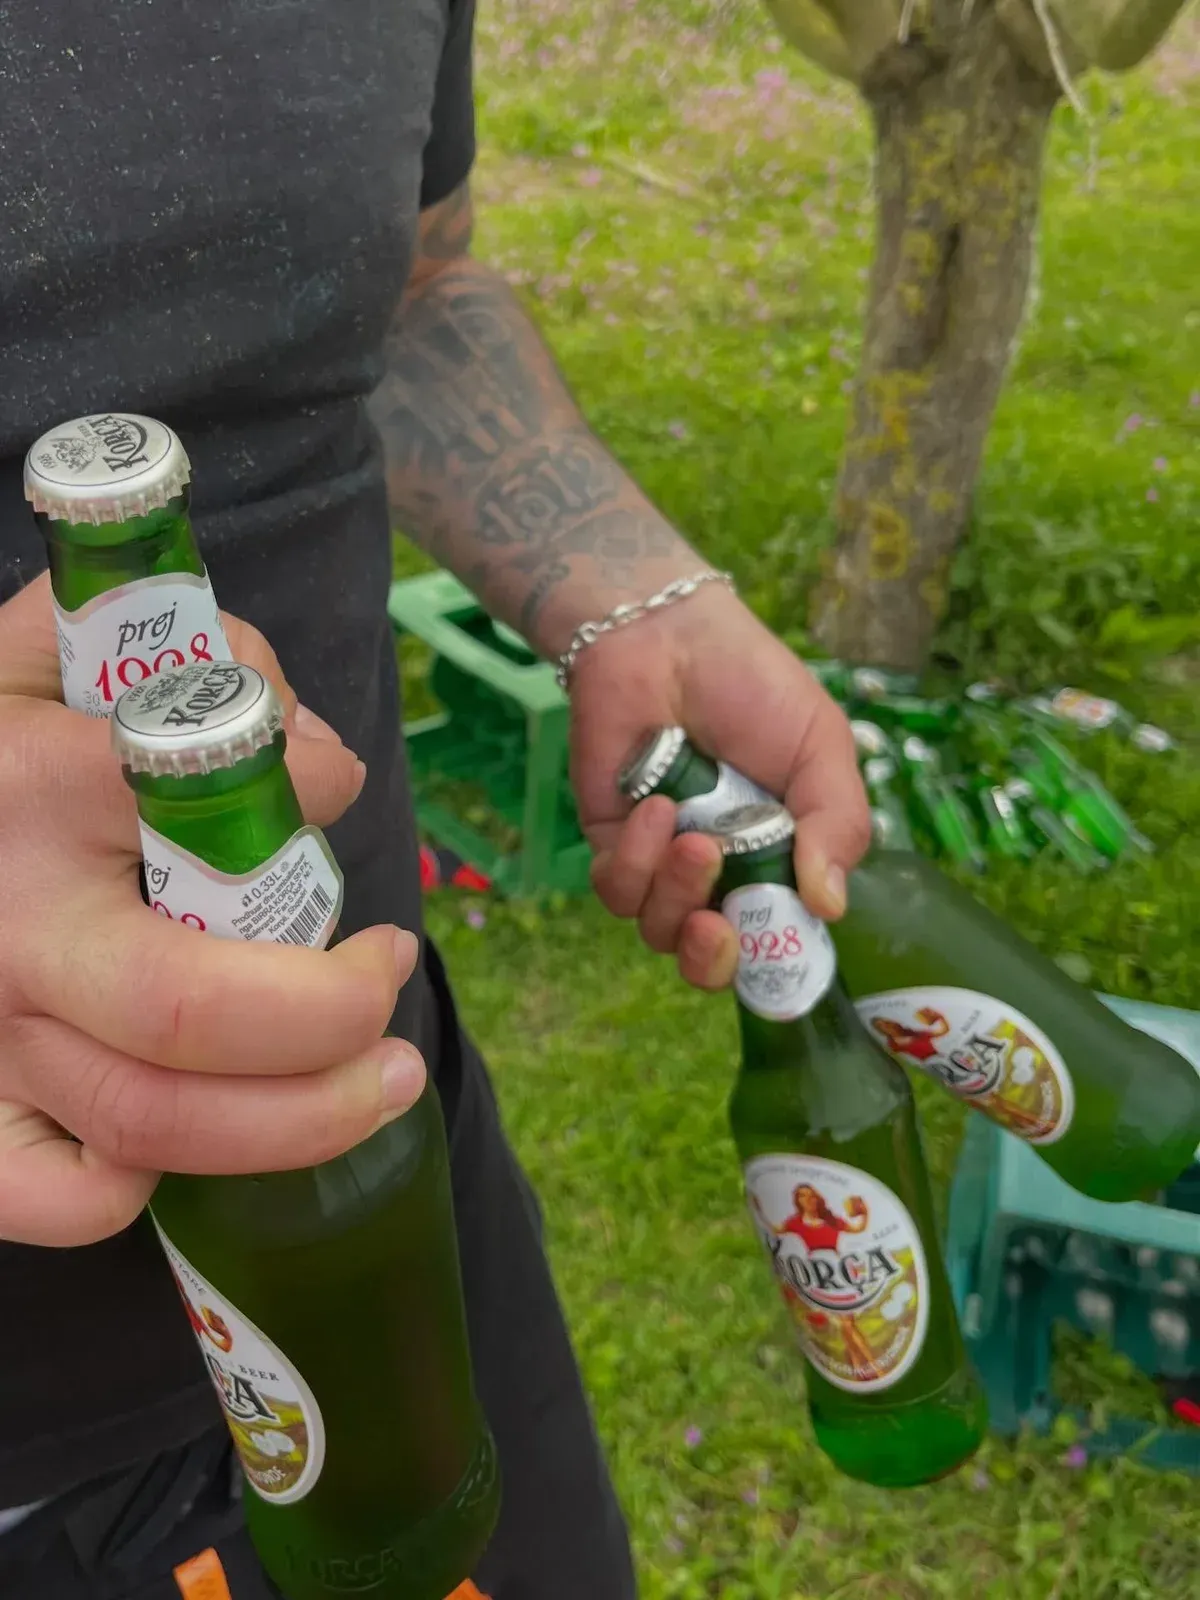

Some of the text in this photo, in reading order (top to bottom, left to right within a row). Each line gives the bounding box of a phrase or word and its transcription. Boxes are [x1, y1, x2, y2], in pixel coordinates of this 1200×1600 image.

[89, 415, 148, 472] KORÇA
[116, 601, 177, 656] prej
[162, 665, 240, 727] KORÇA
[145, 859, 172, 895] rej
[251, 871, 283, 899] 0.33L
[231, 901, 263, 927] Prodhuar
[261, 890, 276, 905] dhe
[239, 922, 252, 934] nga
[251, 904, 274, 924] BIRRA
[272, 881, 295, 905] KORÇA
[739, 903, 772, 930] prej
[740, 925, 802, 963] 928
[238, 1364, 280, 1382] BEER
